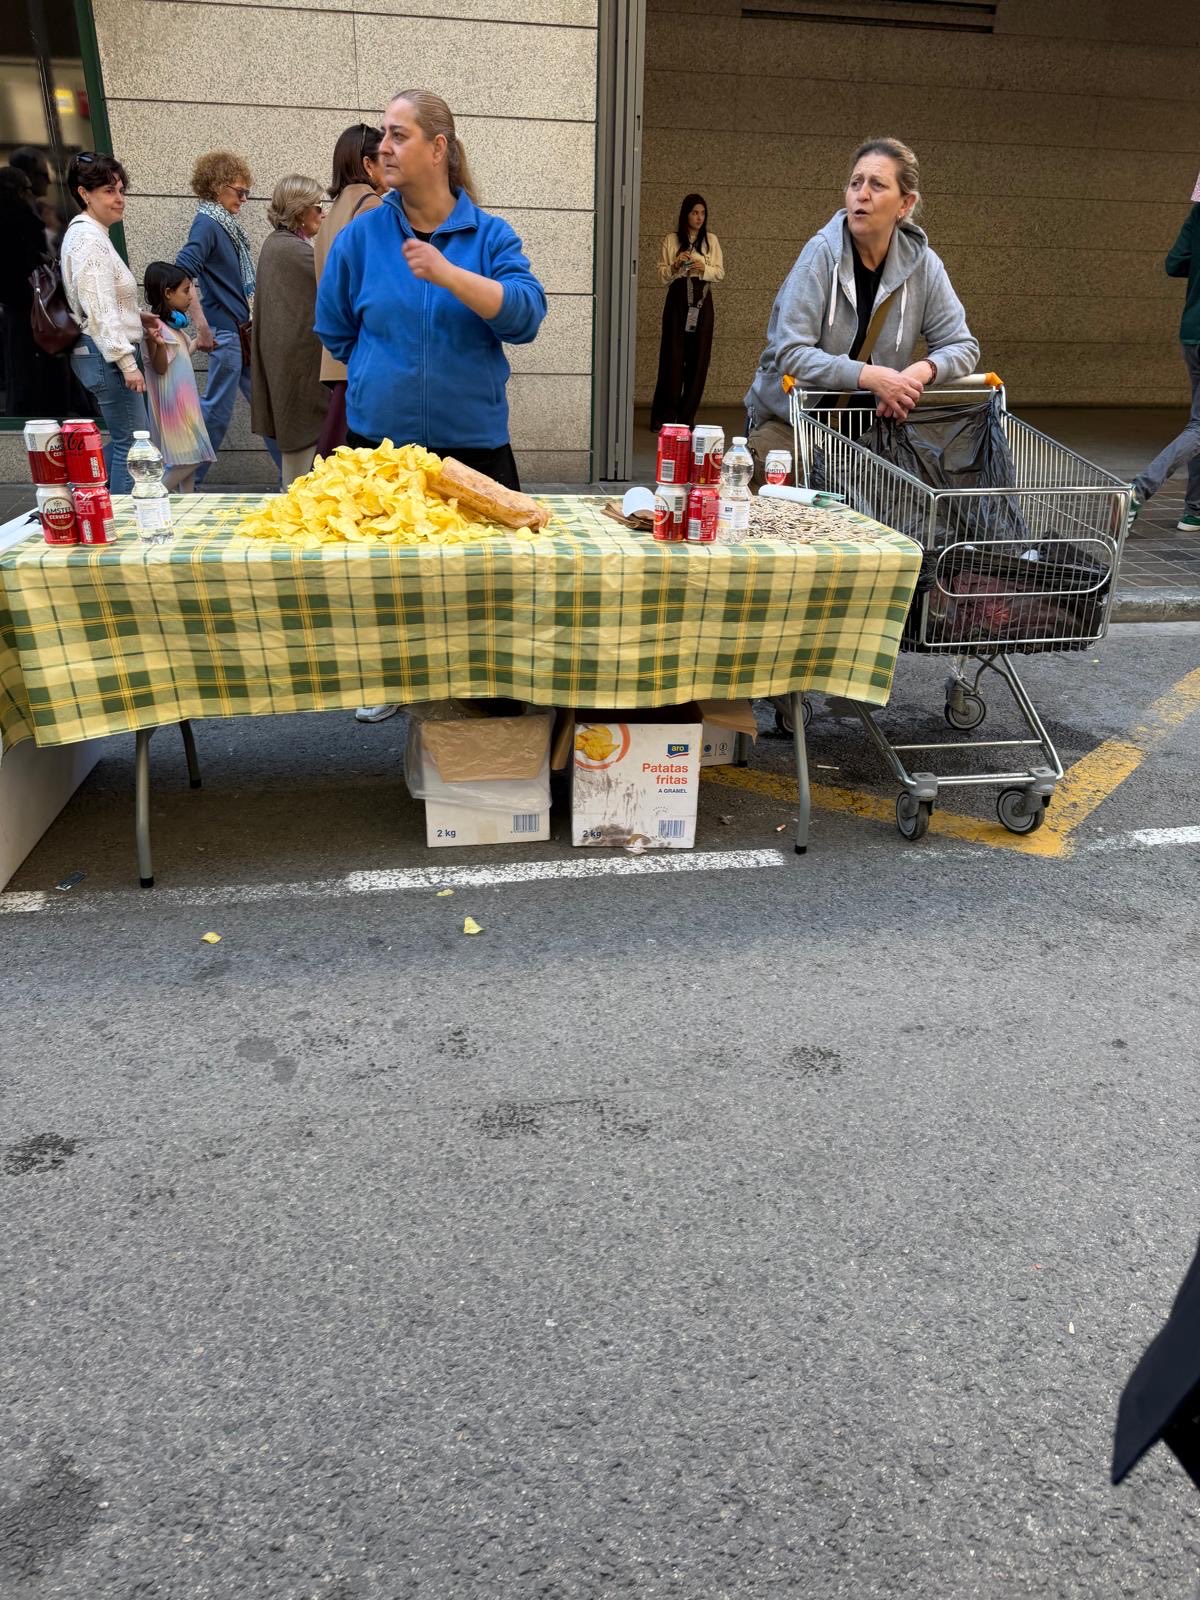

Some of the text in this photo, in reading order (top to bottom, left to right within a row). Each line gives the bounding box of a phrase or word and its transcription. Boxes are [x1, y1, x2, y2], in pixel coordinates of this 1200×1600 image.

[46, 506, 72, 514] AMSTEL
[642, 763, 689, 773] Patatas
[656, 775, 688, 785] fritas
[437, 829, 457, 838] 2 kg
[582, 830, 602, 839] 2 kg
